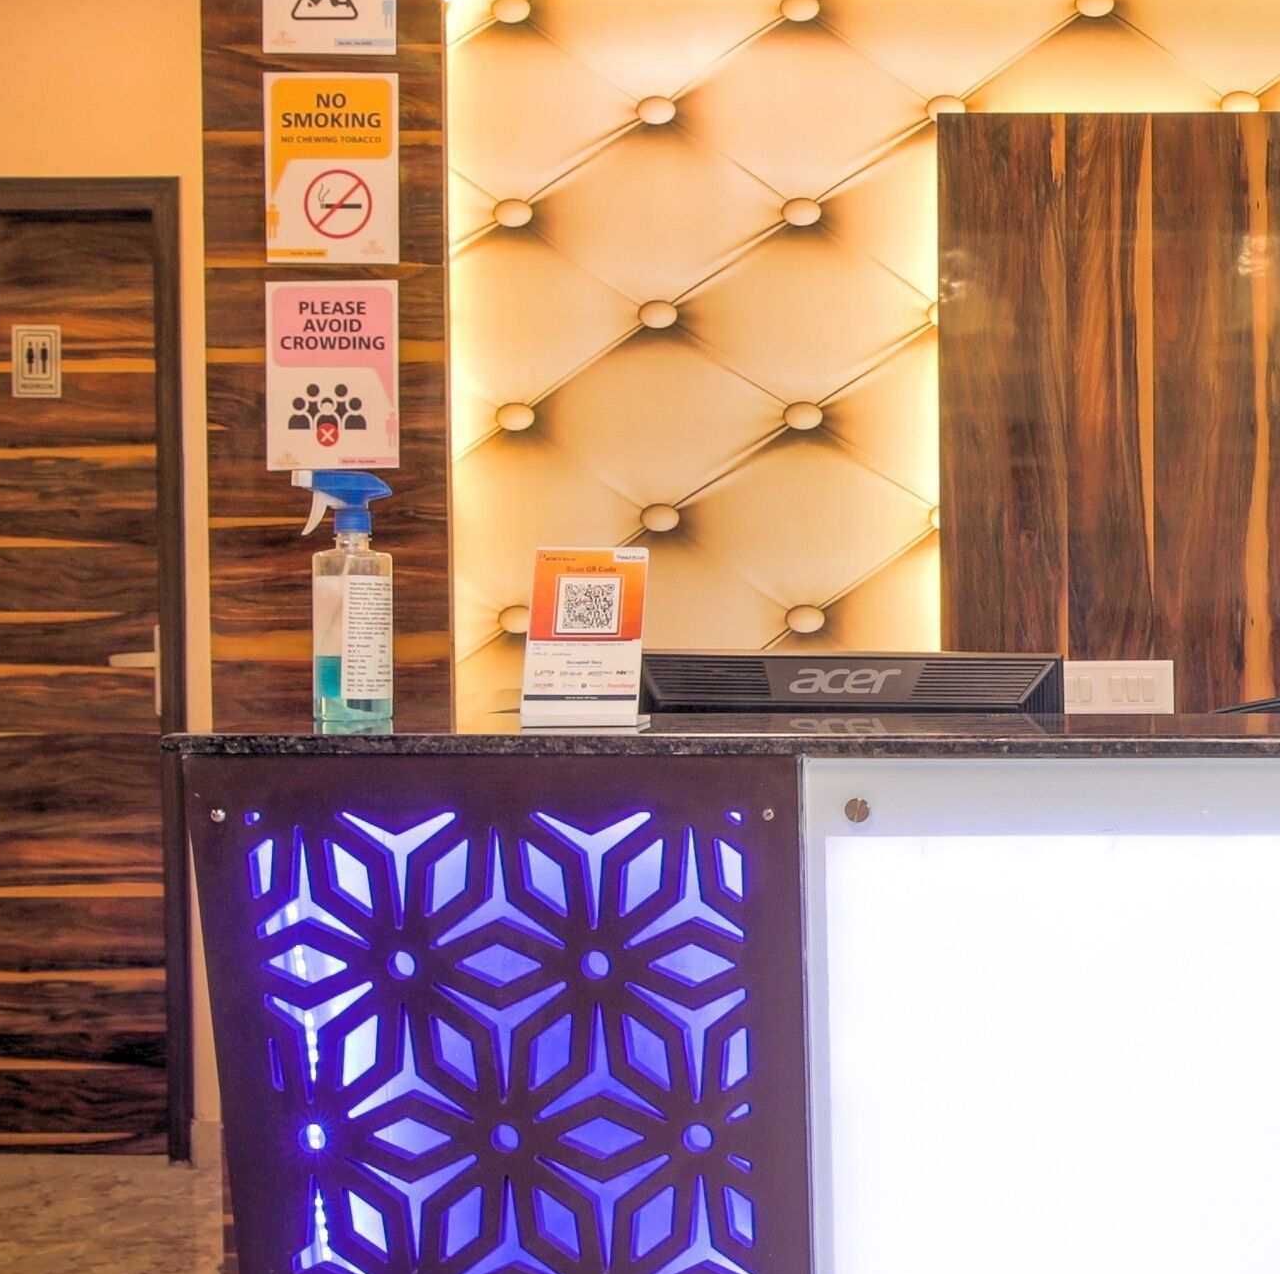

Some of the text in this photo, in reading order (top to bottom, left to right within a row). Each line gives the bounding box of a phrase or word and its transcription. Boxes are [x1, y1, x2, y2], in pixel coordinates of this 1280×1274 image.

[316, 93, 346, 108] NO
[281, 112, 381, 128] SMOKING
[299, 301, 366, 315] PLEASE
[303, 319, 362, 332] AVOID
[280, 336, 385, 350] CROWDING
[788, 668, 901, 694] acer
